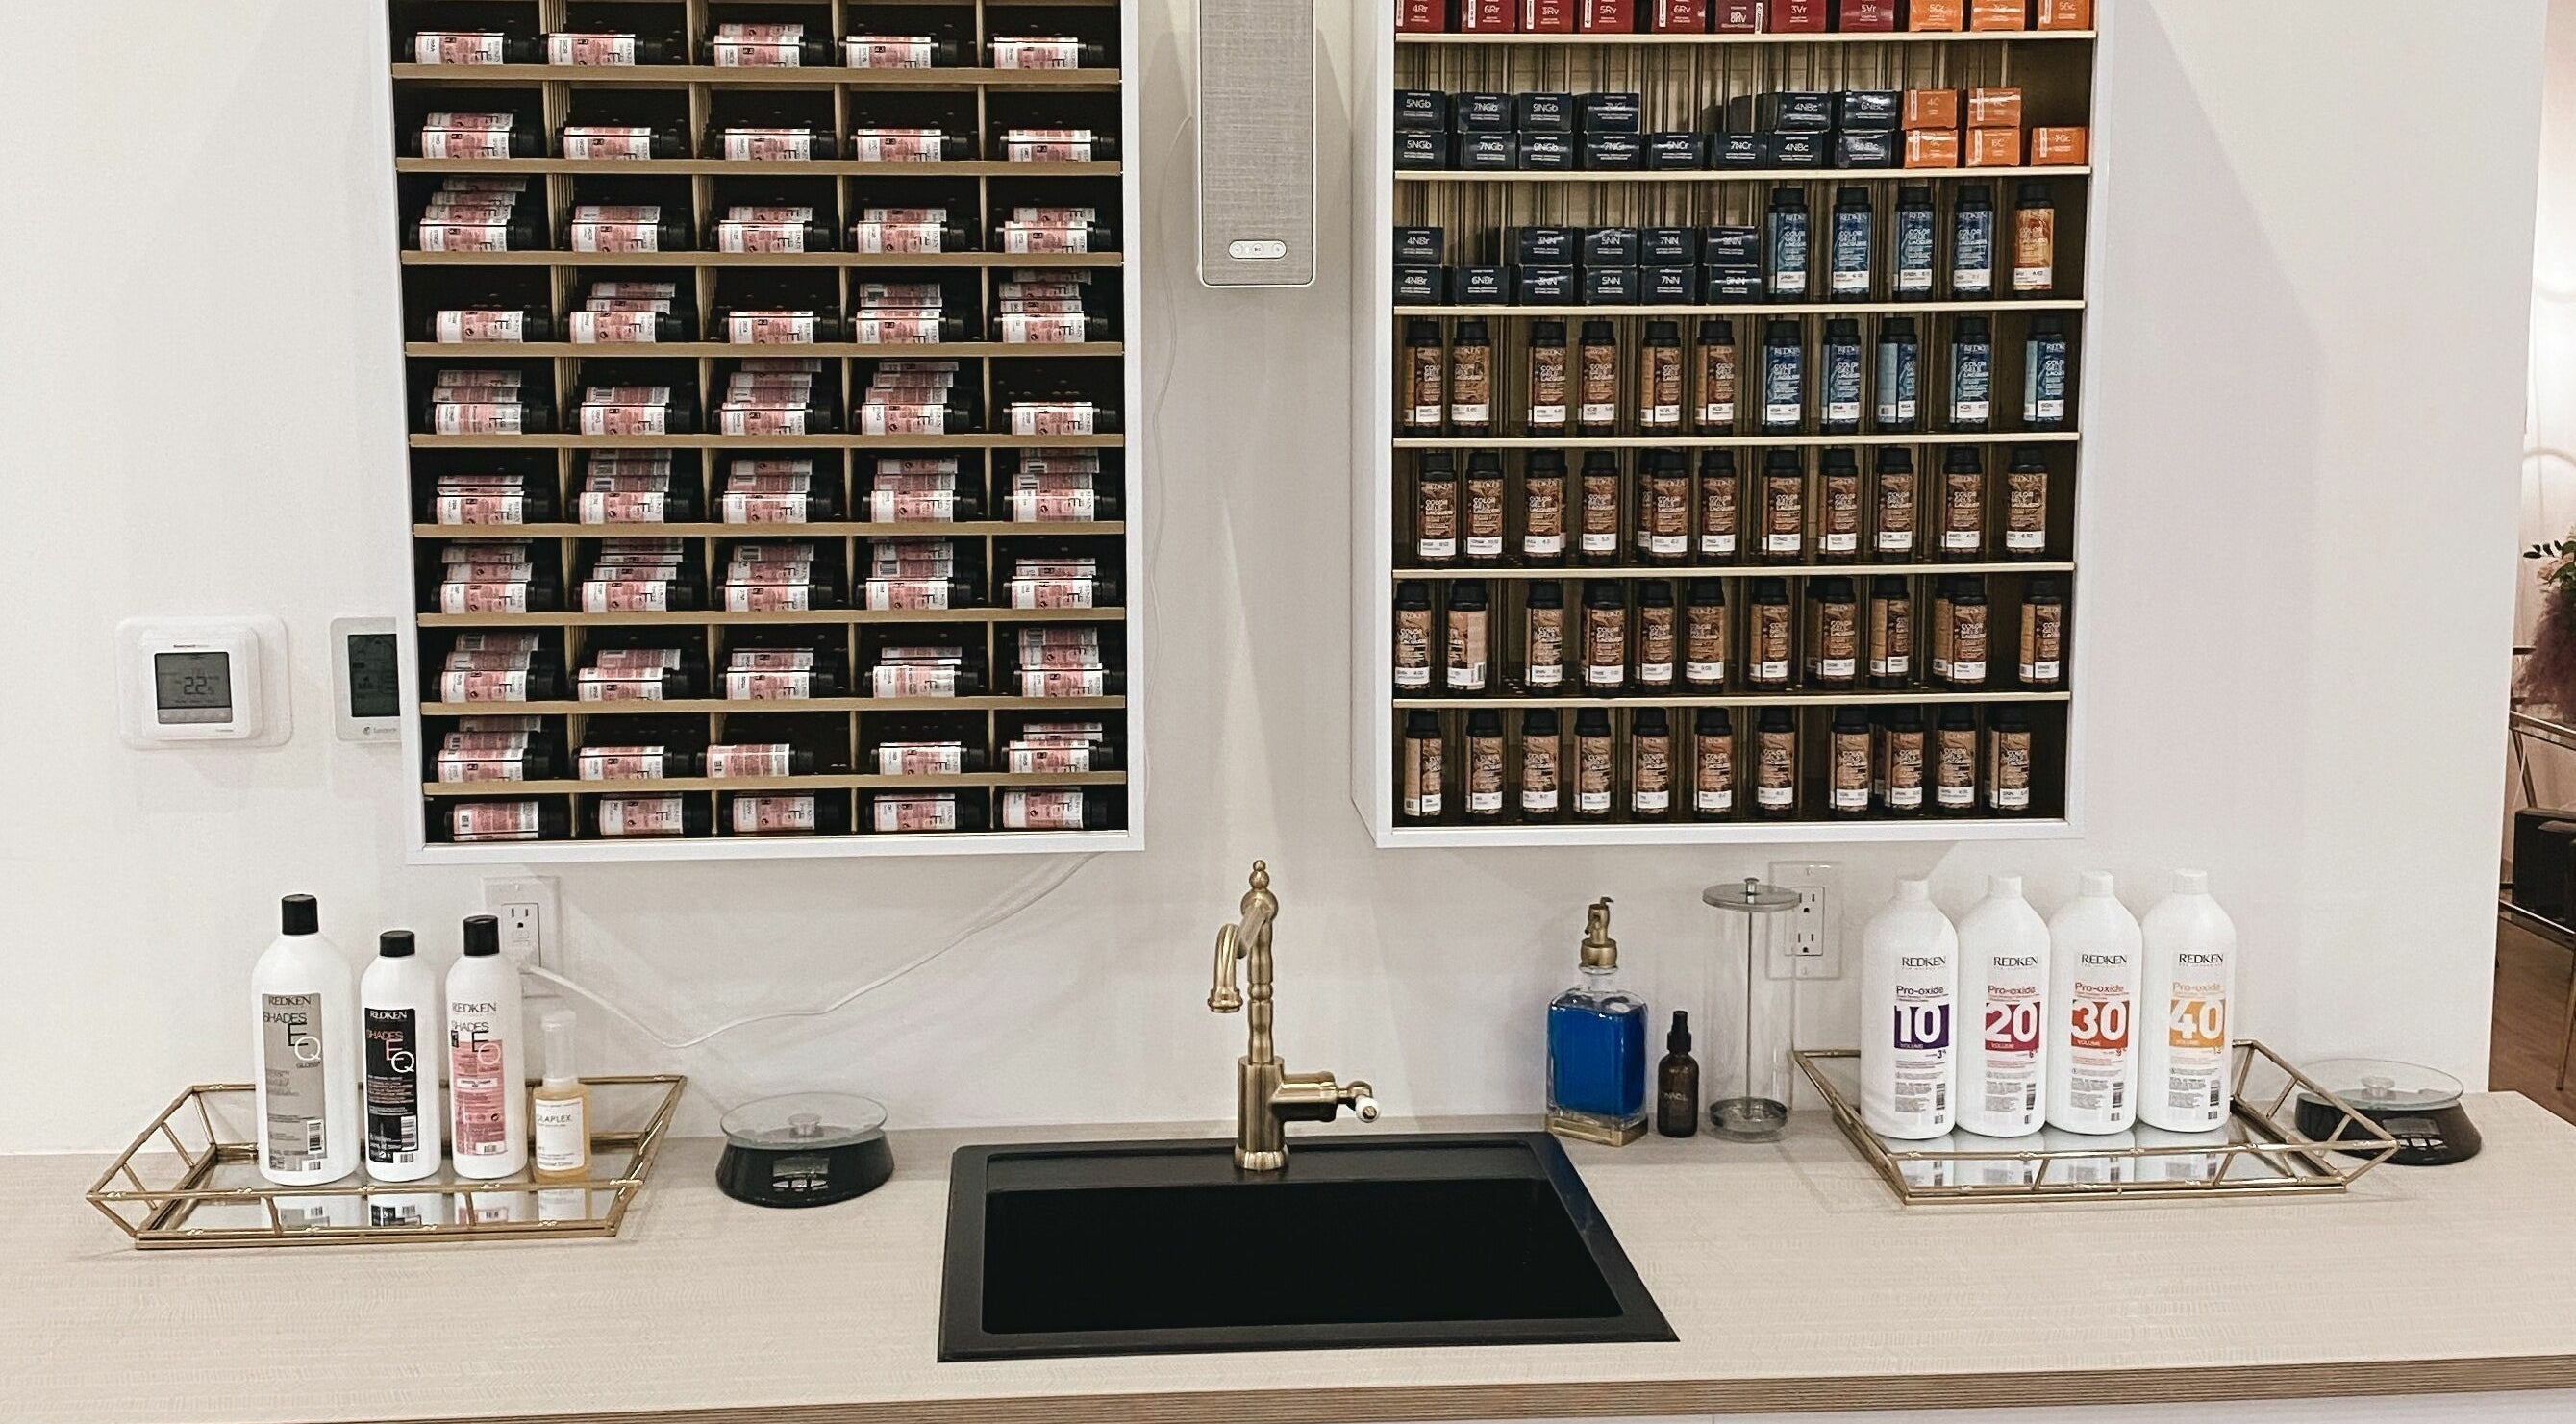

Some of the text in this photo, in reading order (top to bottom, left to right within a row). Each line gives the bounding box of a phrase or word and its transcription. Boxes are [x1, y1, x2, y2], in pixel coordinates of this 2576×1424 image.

[1902, 956, 1946, 967] REDKEN
[1993, 956, 2038, 967] REDKEN
[2082, 954, 2127, 965] REDKEN
[2179, 953, 2224, 964] REDKEN
[1896, 986, 1944, 995] Pro-oxide
[1988, 985, 2036, 995] Pro-oxide
[2075, 982, 2124, 993] Pro-oxide
[268, 995, 311, 1006] REDKEN
[452, 1001, 497, 1013] REDKEN
[263, 1011, 308, 1024] SHADES
[369, 1011, 408, 1020] REDKEN
[2071, 999, 2127, 1041] 30
[2170, 999, 2223, 1040] 40
[1896, 1005, 1941, 1044] 10
[1986, 1003, 2038, 1043] 20
[288, 1022, 309, 1047] E
[472, 1031, 490, 1053] E
[294, 1036, 322, 1061] Q
[386, 1038, 405, 1061] E
[390, 1051, 415, 1073] Q
